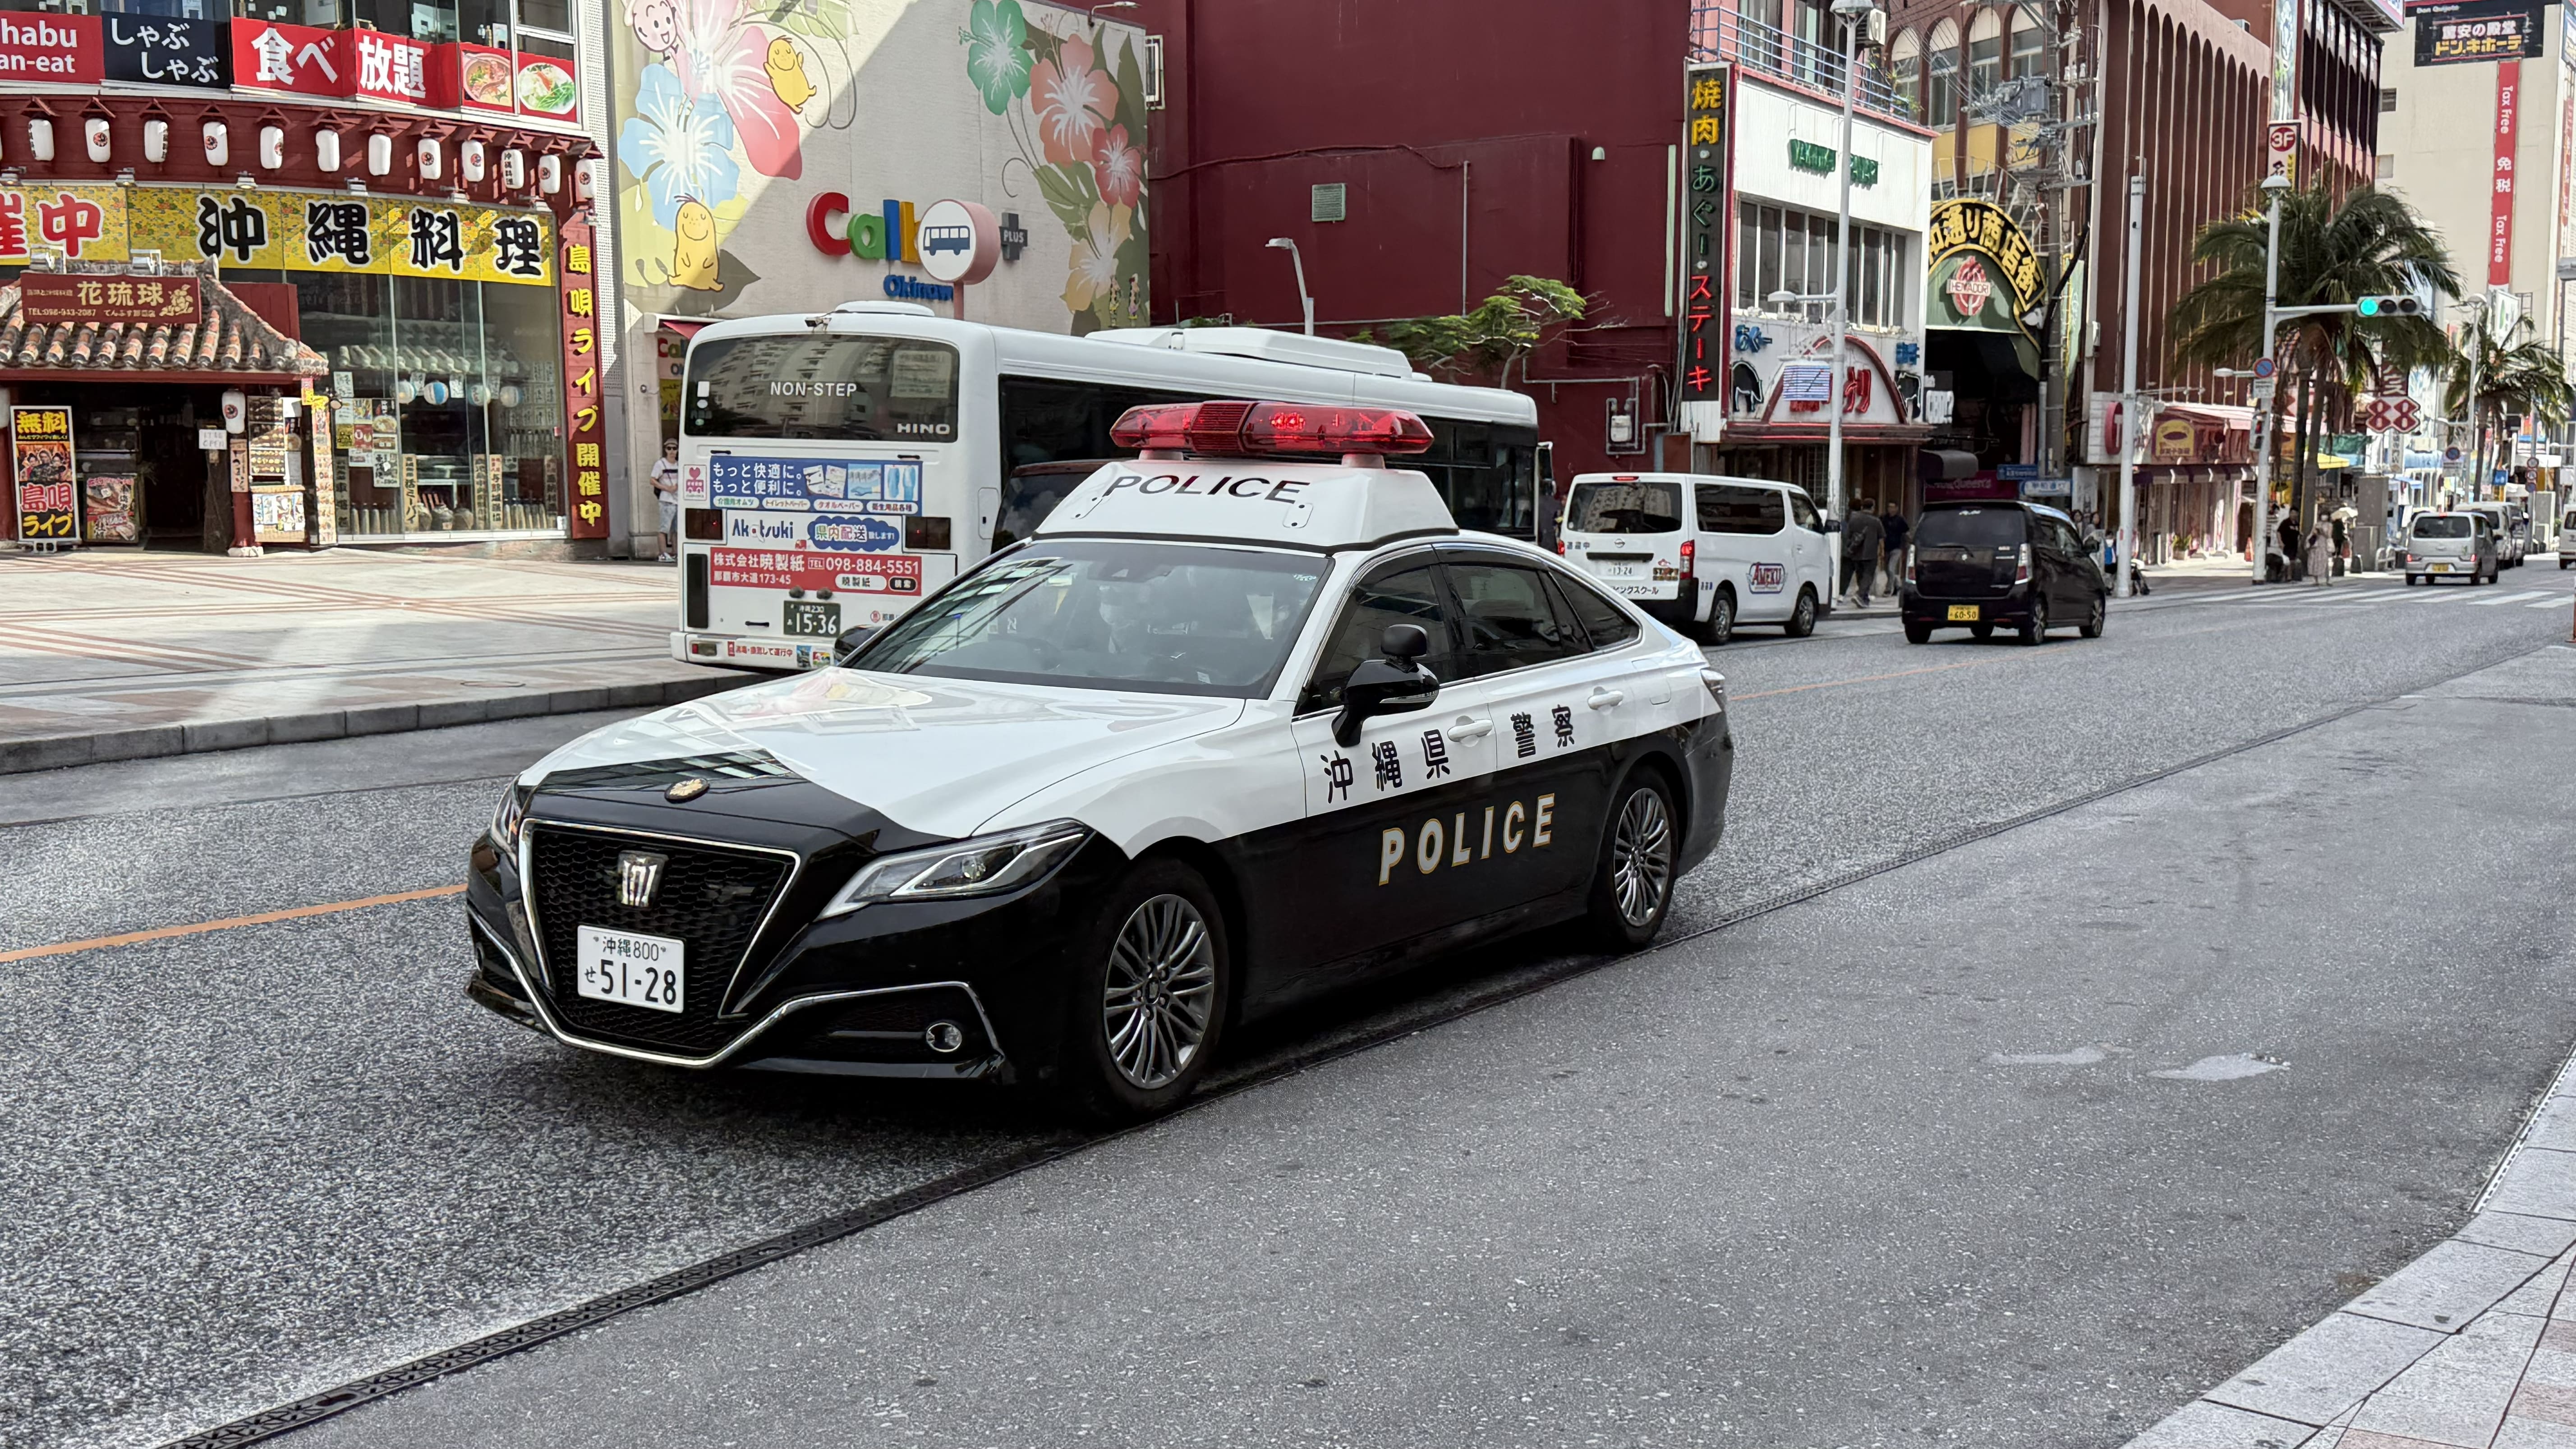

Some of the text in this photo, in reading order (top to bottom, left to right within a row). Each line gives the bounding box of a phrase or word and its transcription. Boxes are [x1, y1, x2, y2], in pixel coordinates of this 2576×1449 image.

[111, 18, 190, 49] しゃぶ
[141, 51, 220, 83] しゃぶ
[251, 26, 426, 99] 食べ放題
[2271, 131, 2295, 147] 3F
[2496, 156, 2512, 193] 免税
[198, 197, 543, 276] 沖縄料理
[1003, 229, 1025, 244] PLUS
[77, 281, 164, 306] 花琉球
[883, 274, 954, 301] Okinaw
[566, 243, 602, 527] 島唄ライブ開催中
[770, 381, 857, 398] NON-STEP
[16, 411, 68, 434] 無料
[897, 422, 951, 435] HINO
[713, 462, 802, 480] もっと快適に。
[21, 483, 73, 513] 島唄
[713, 478, 802, 496] もっと便利に。
[1102, 475, 1311, 505] POLICE
[818, 501, 861, 510] タオルペーパー
[22, 513, 73, 537] ライブ
[732, 518, 794, 543] Akatsuki
[809, 557, 919, 575] TEL 098-884-5551
[1320, 704, 1575, 804] 沖縄県 警察
[1378, 792, 1555, 886] POLICE
[602, 935, 659, 962] 沖縄800
[584, 959, 676, 1005] せ 51-28
